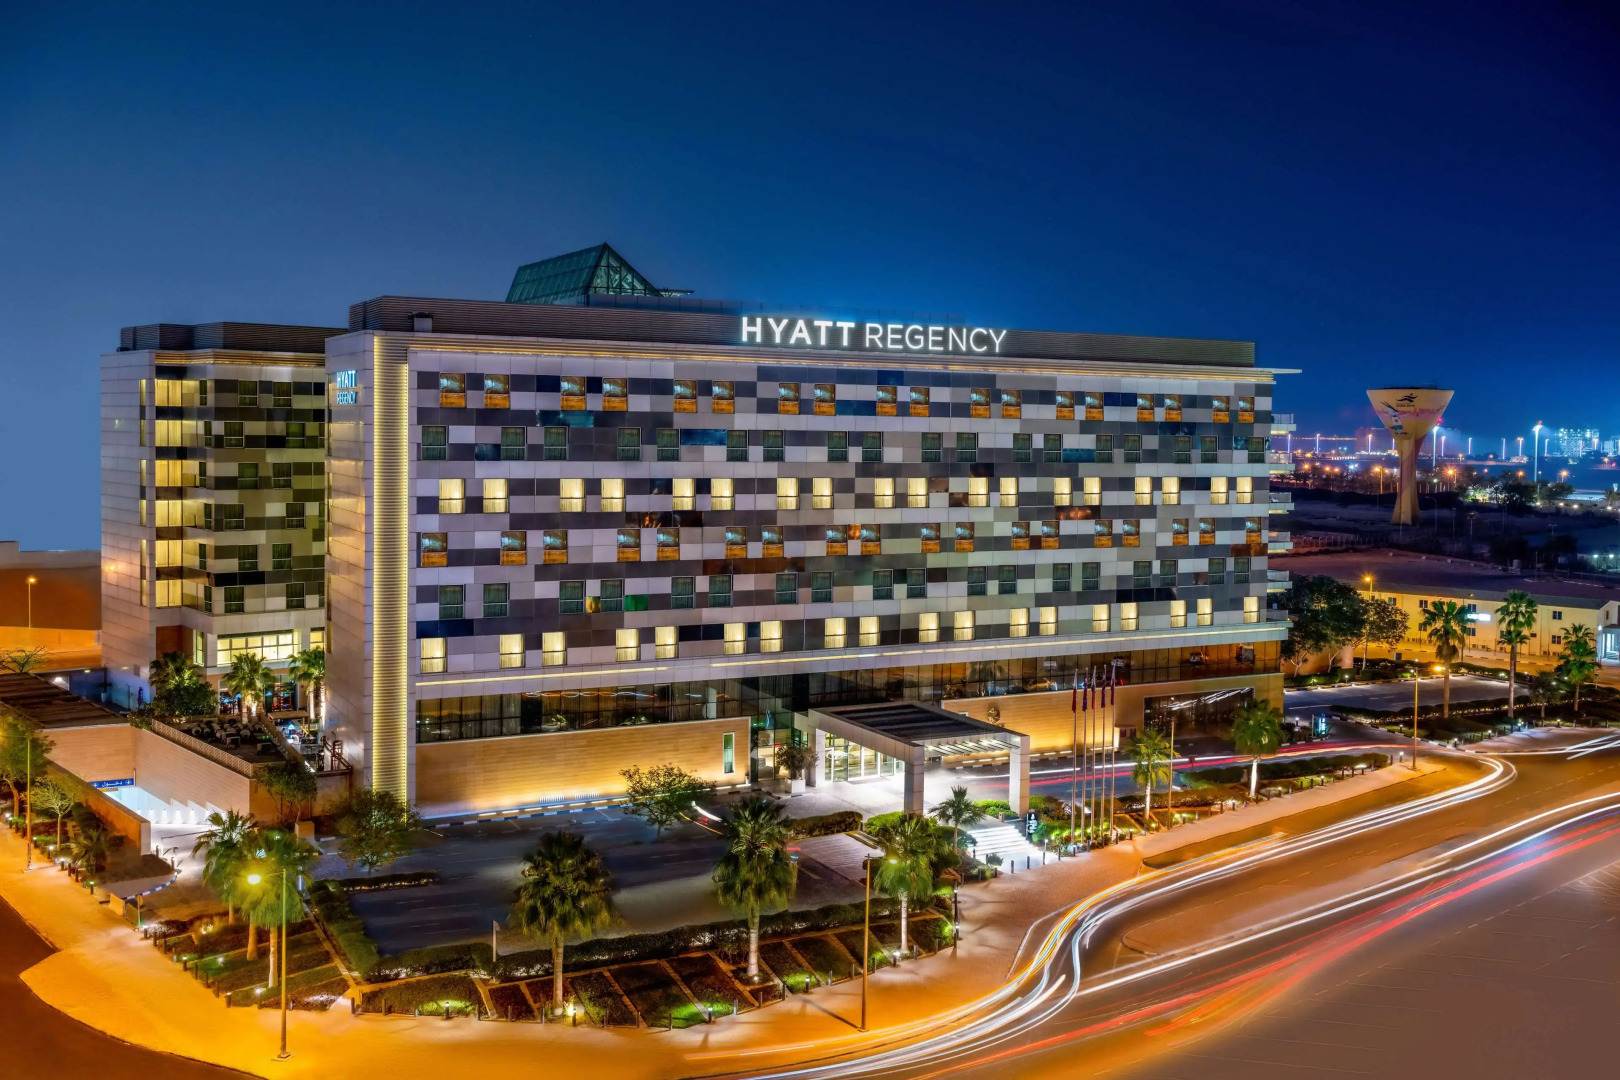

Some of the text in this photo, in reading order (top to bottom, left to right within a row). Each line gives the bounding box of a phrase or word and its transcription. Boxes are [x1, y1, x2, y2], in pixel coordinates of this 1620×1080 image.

[741, 316, 1007, 353] HYATT REGENCY
[336, 370, 356, 388] HYATT
